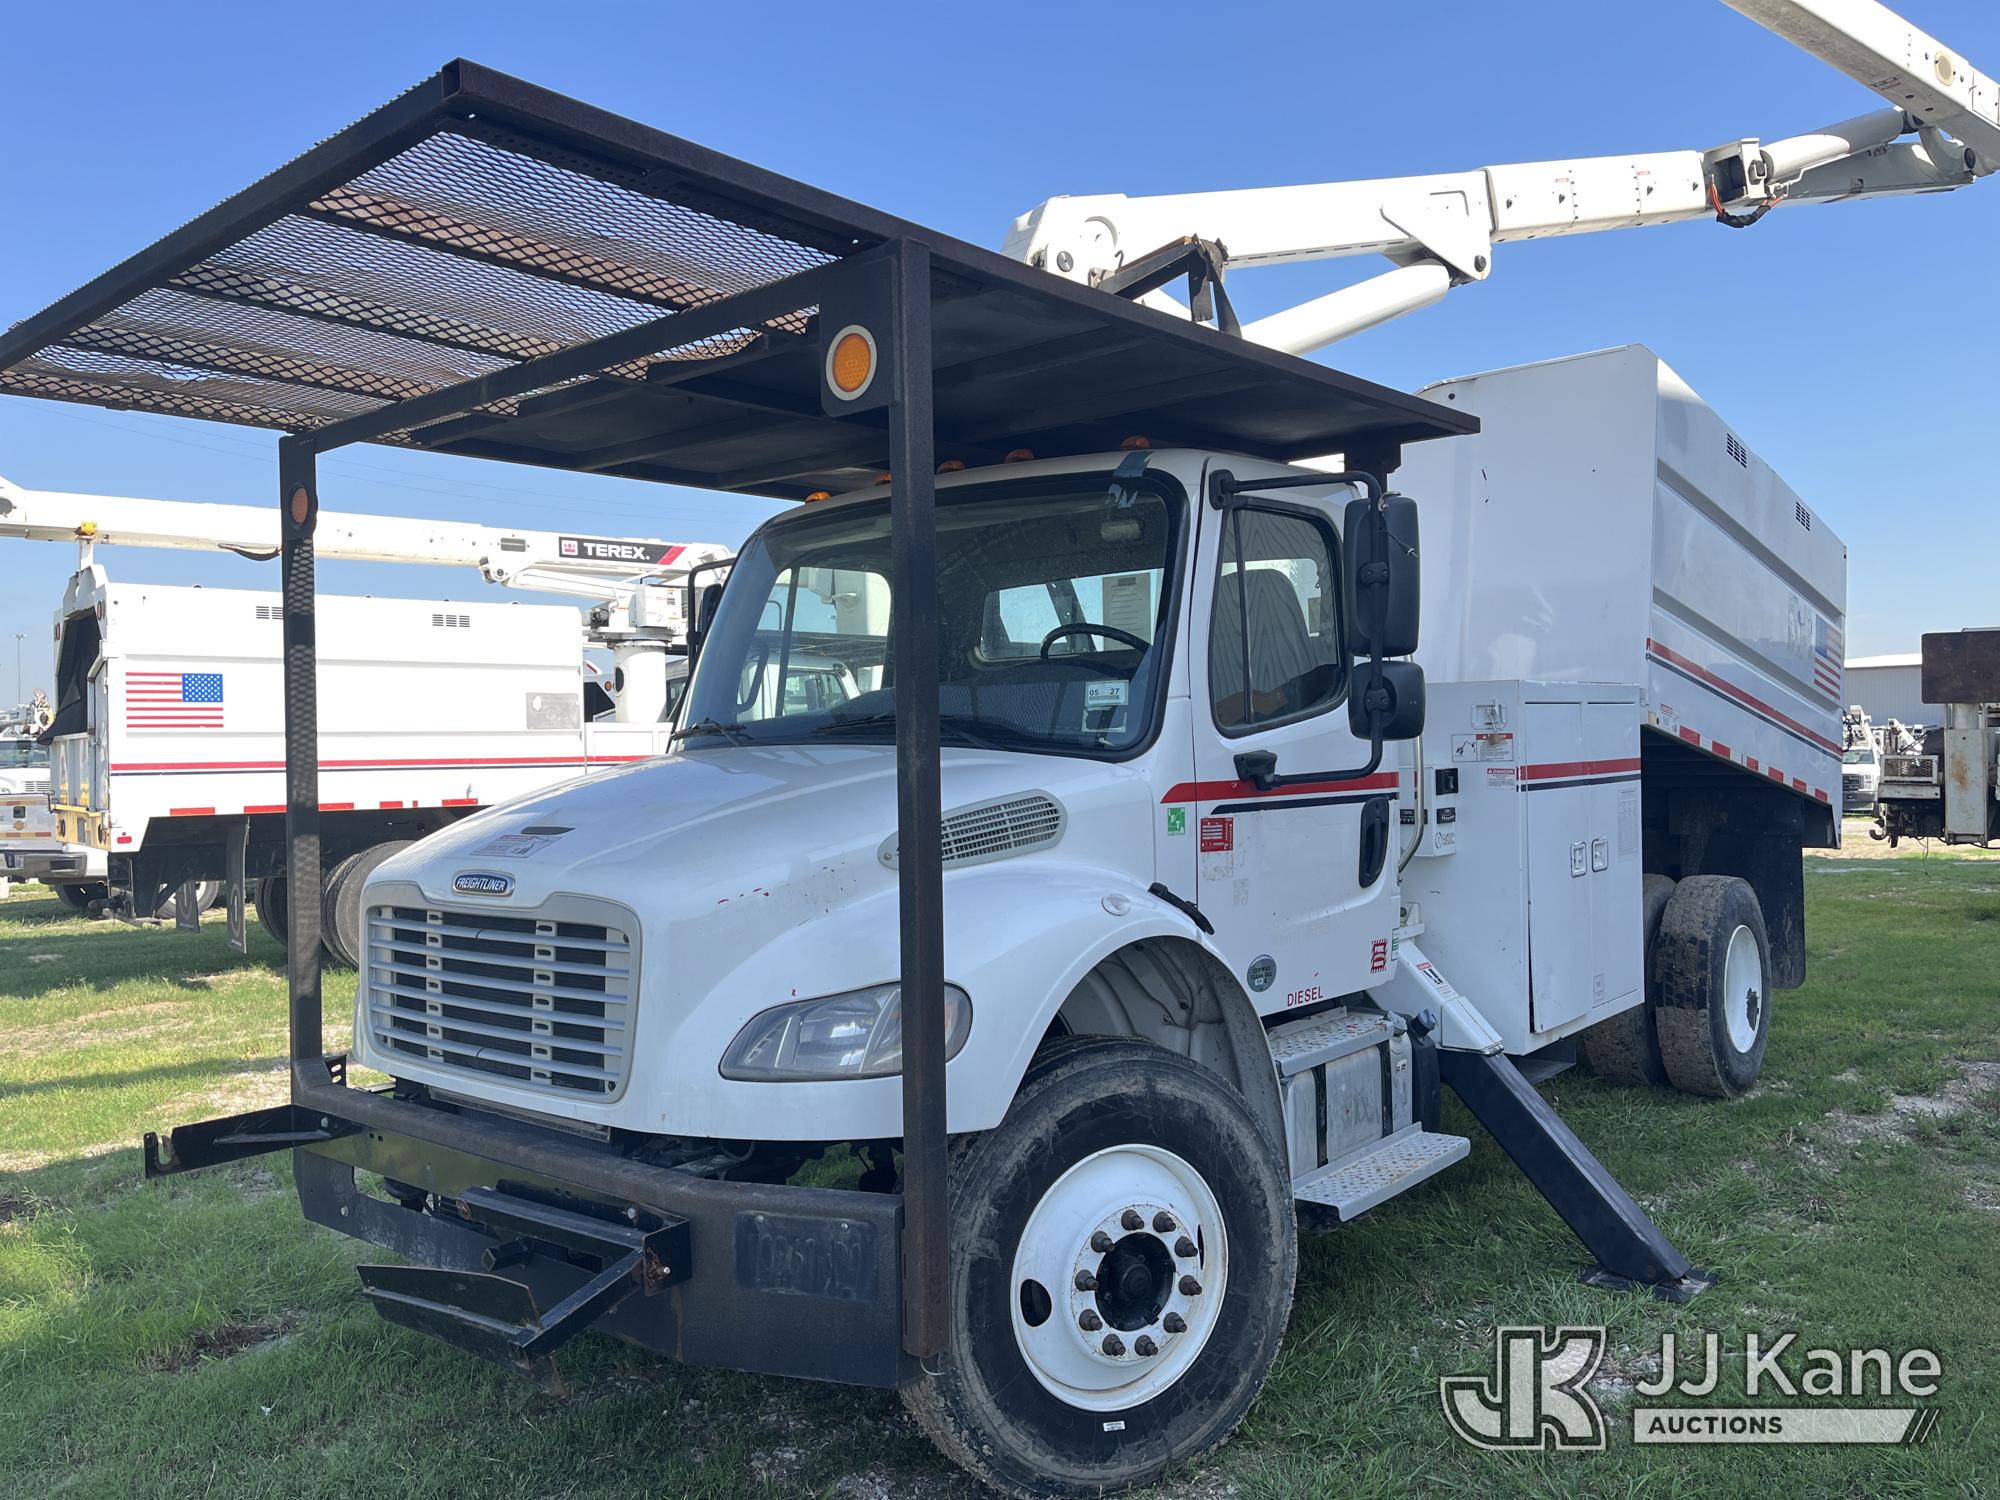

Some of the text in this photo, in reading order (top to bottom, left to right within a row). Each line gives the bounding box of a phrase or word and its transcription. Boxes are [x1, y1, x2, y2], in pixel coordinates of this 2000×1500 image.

[1089, 687, 1120, 696] 05 27
[456, 876, 507, 892] FREIGHTLINER
[1287, 985, 1324, 1007] DIESEL
